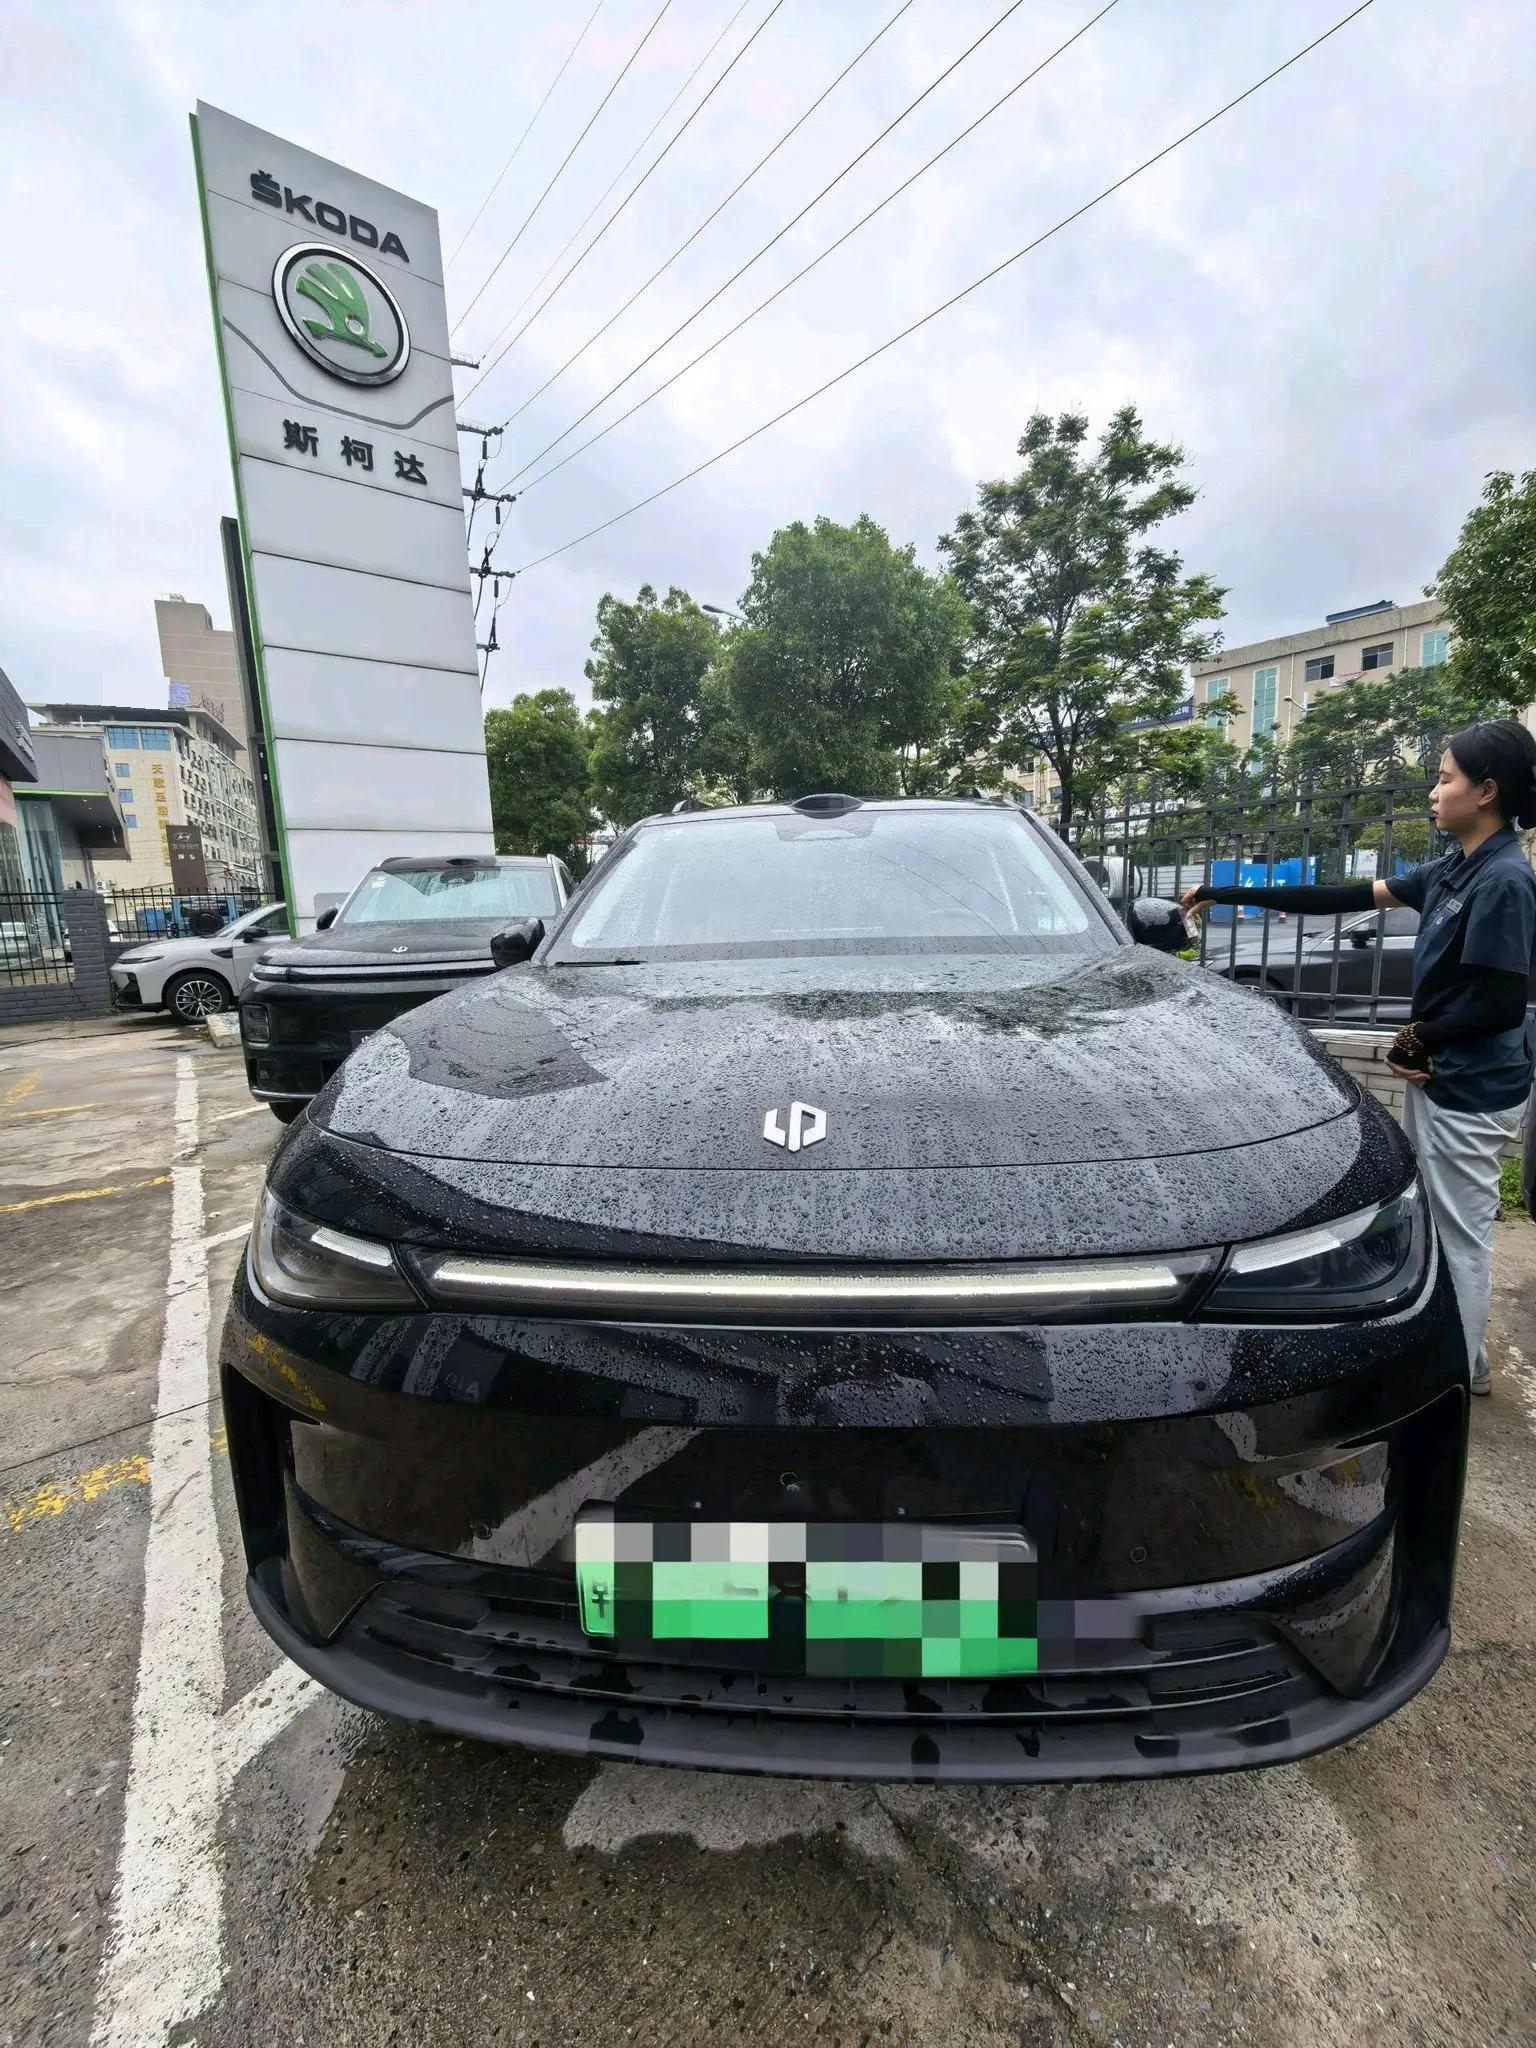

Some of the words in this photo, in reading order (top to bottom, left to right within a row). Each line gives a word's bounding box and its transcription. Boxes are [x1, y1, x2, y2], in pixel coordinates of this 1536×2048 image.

[250, 169, 410, 263] ŠKODA
[282, 419, 428, 485] 斯柯达
